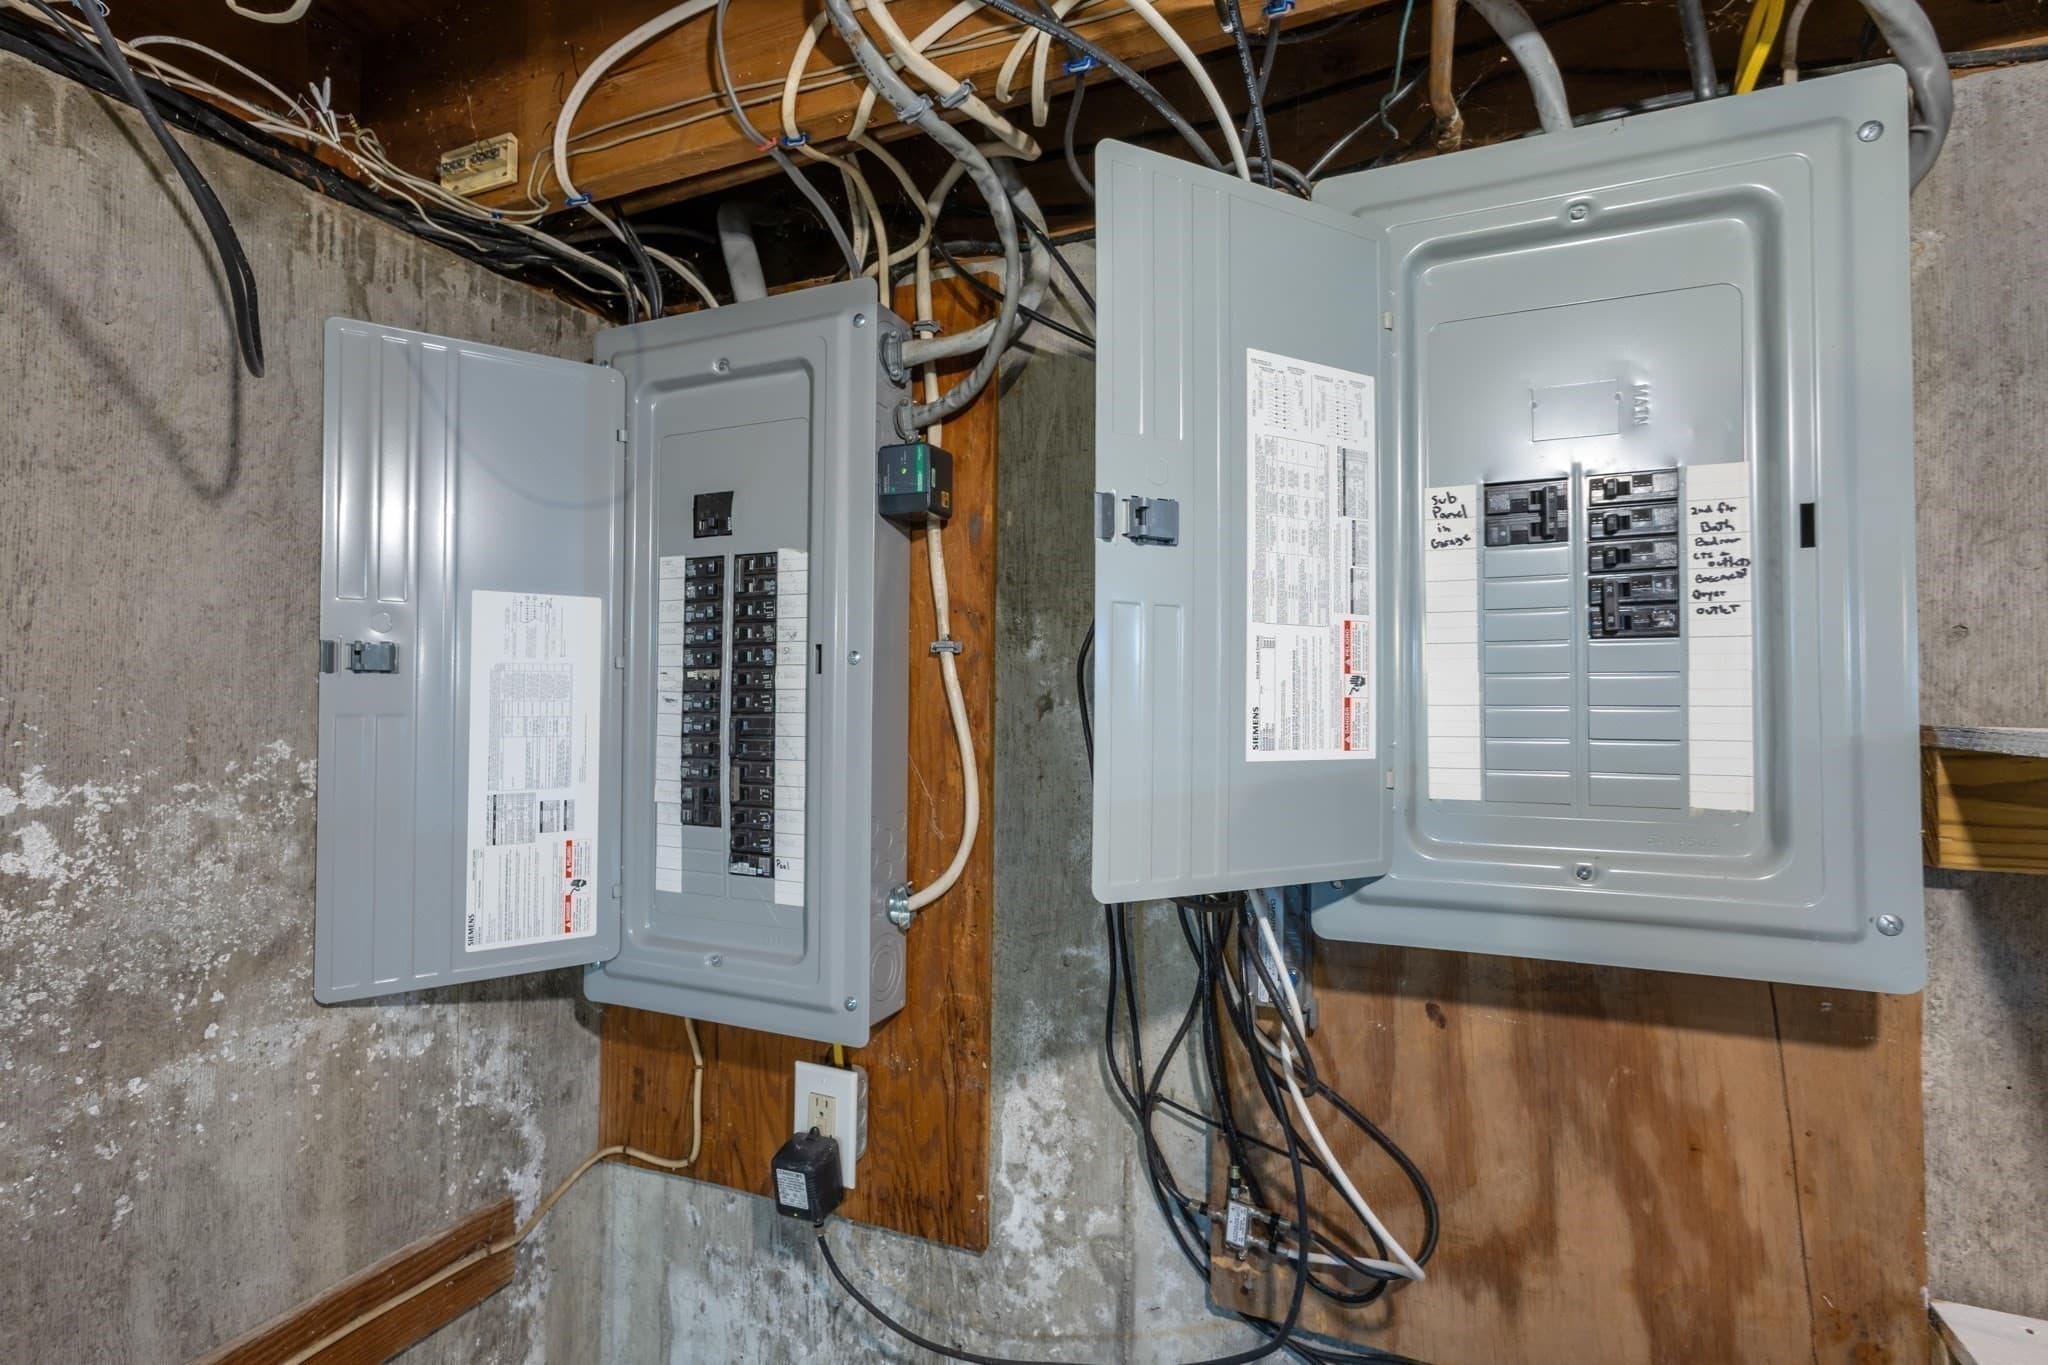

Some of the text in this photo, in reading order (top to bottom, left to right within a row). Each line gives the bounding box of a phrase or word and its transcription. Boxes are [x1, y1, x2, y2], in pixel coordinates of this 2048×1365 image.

[1432, 504, 1468, 519] Panel
[1690, 505, 1713, 515] 2nd
[1437, 522, 1451, 533] in
[1700, 519, 1735, 533] Bath
[1430, 533, 1471, 549] Garage
[1252, 706, 1260, 750] SIEMENS
[467, 913, 475, 946] SIEMENS
